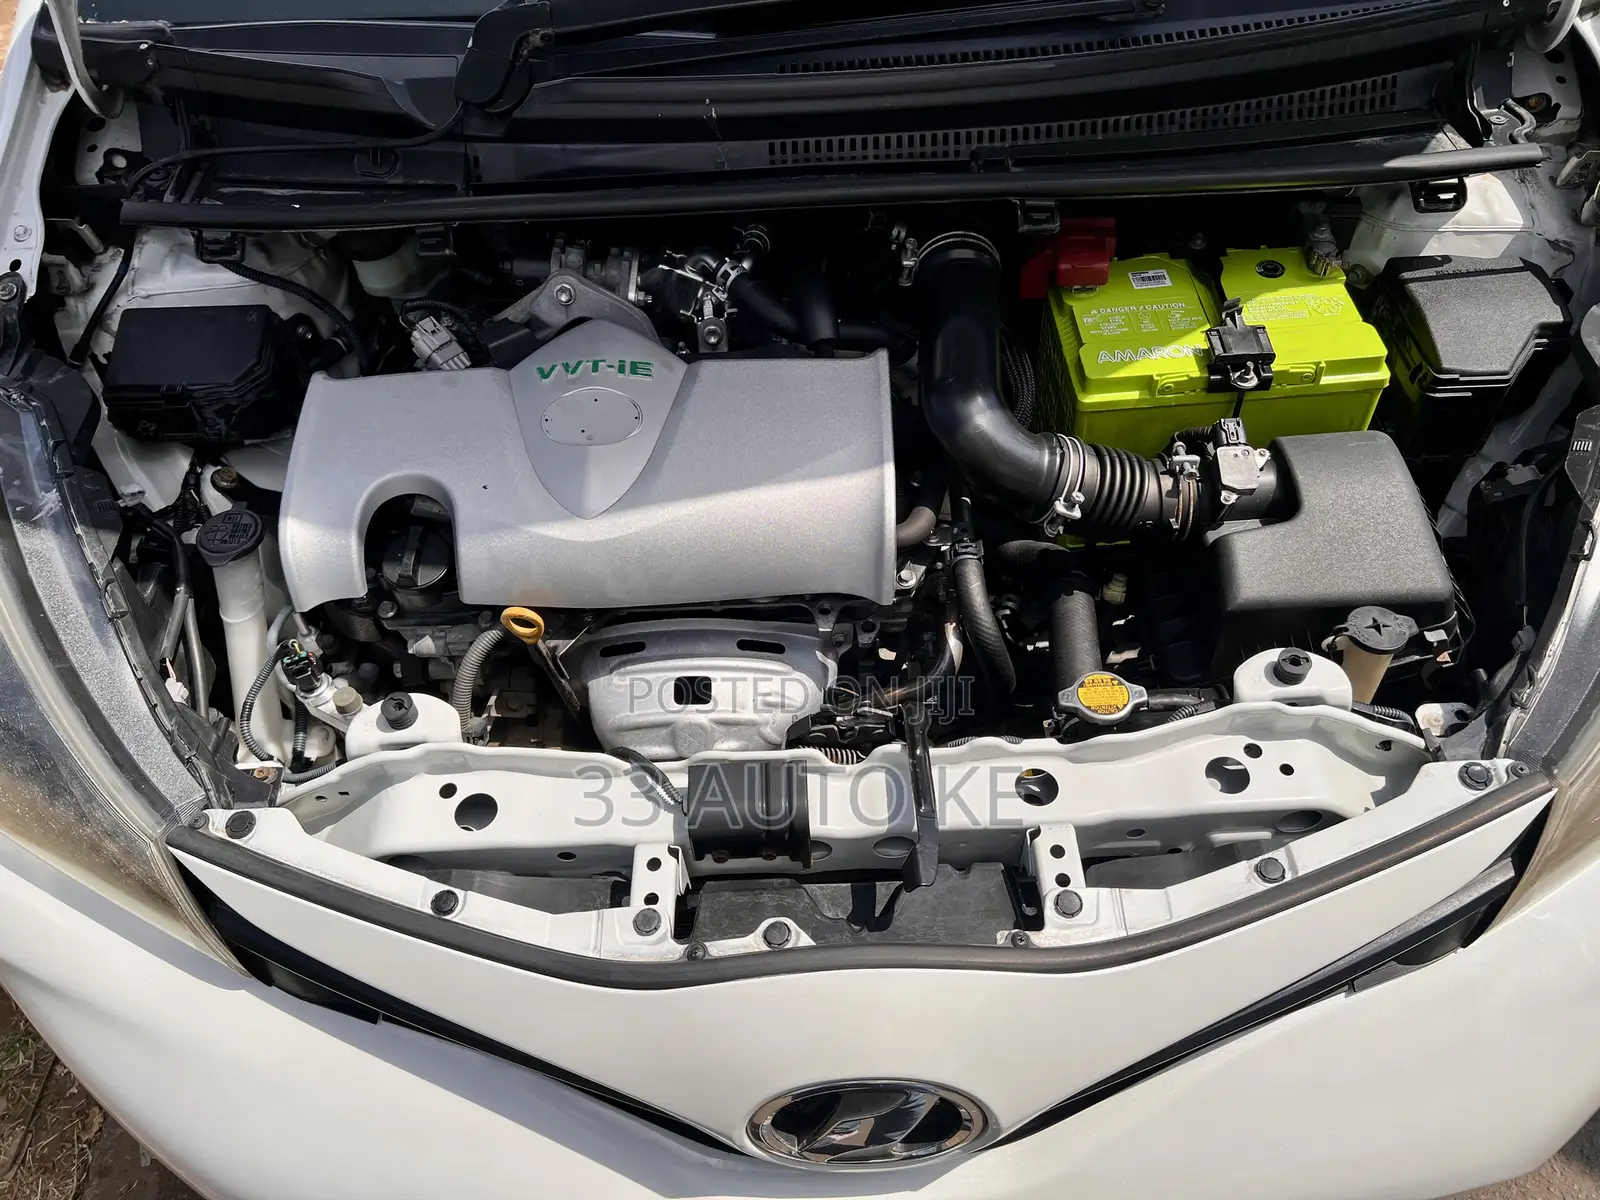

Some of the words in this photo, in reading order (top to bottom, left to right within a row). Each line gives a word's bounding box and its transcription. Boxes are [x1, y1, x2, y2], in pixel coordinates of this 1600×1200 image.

[1100, 306, 1136, 314] DANGER
[1145, 302, 1185, 310] CAUTION
[1098, 344, 1204, 364] AMARON
